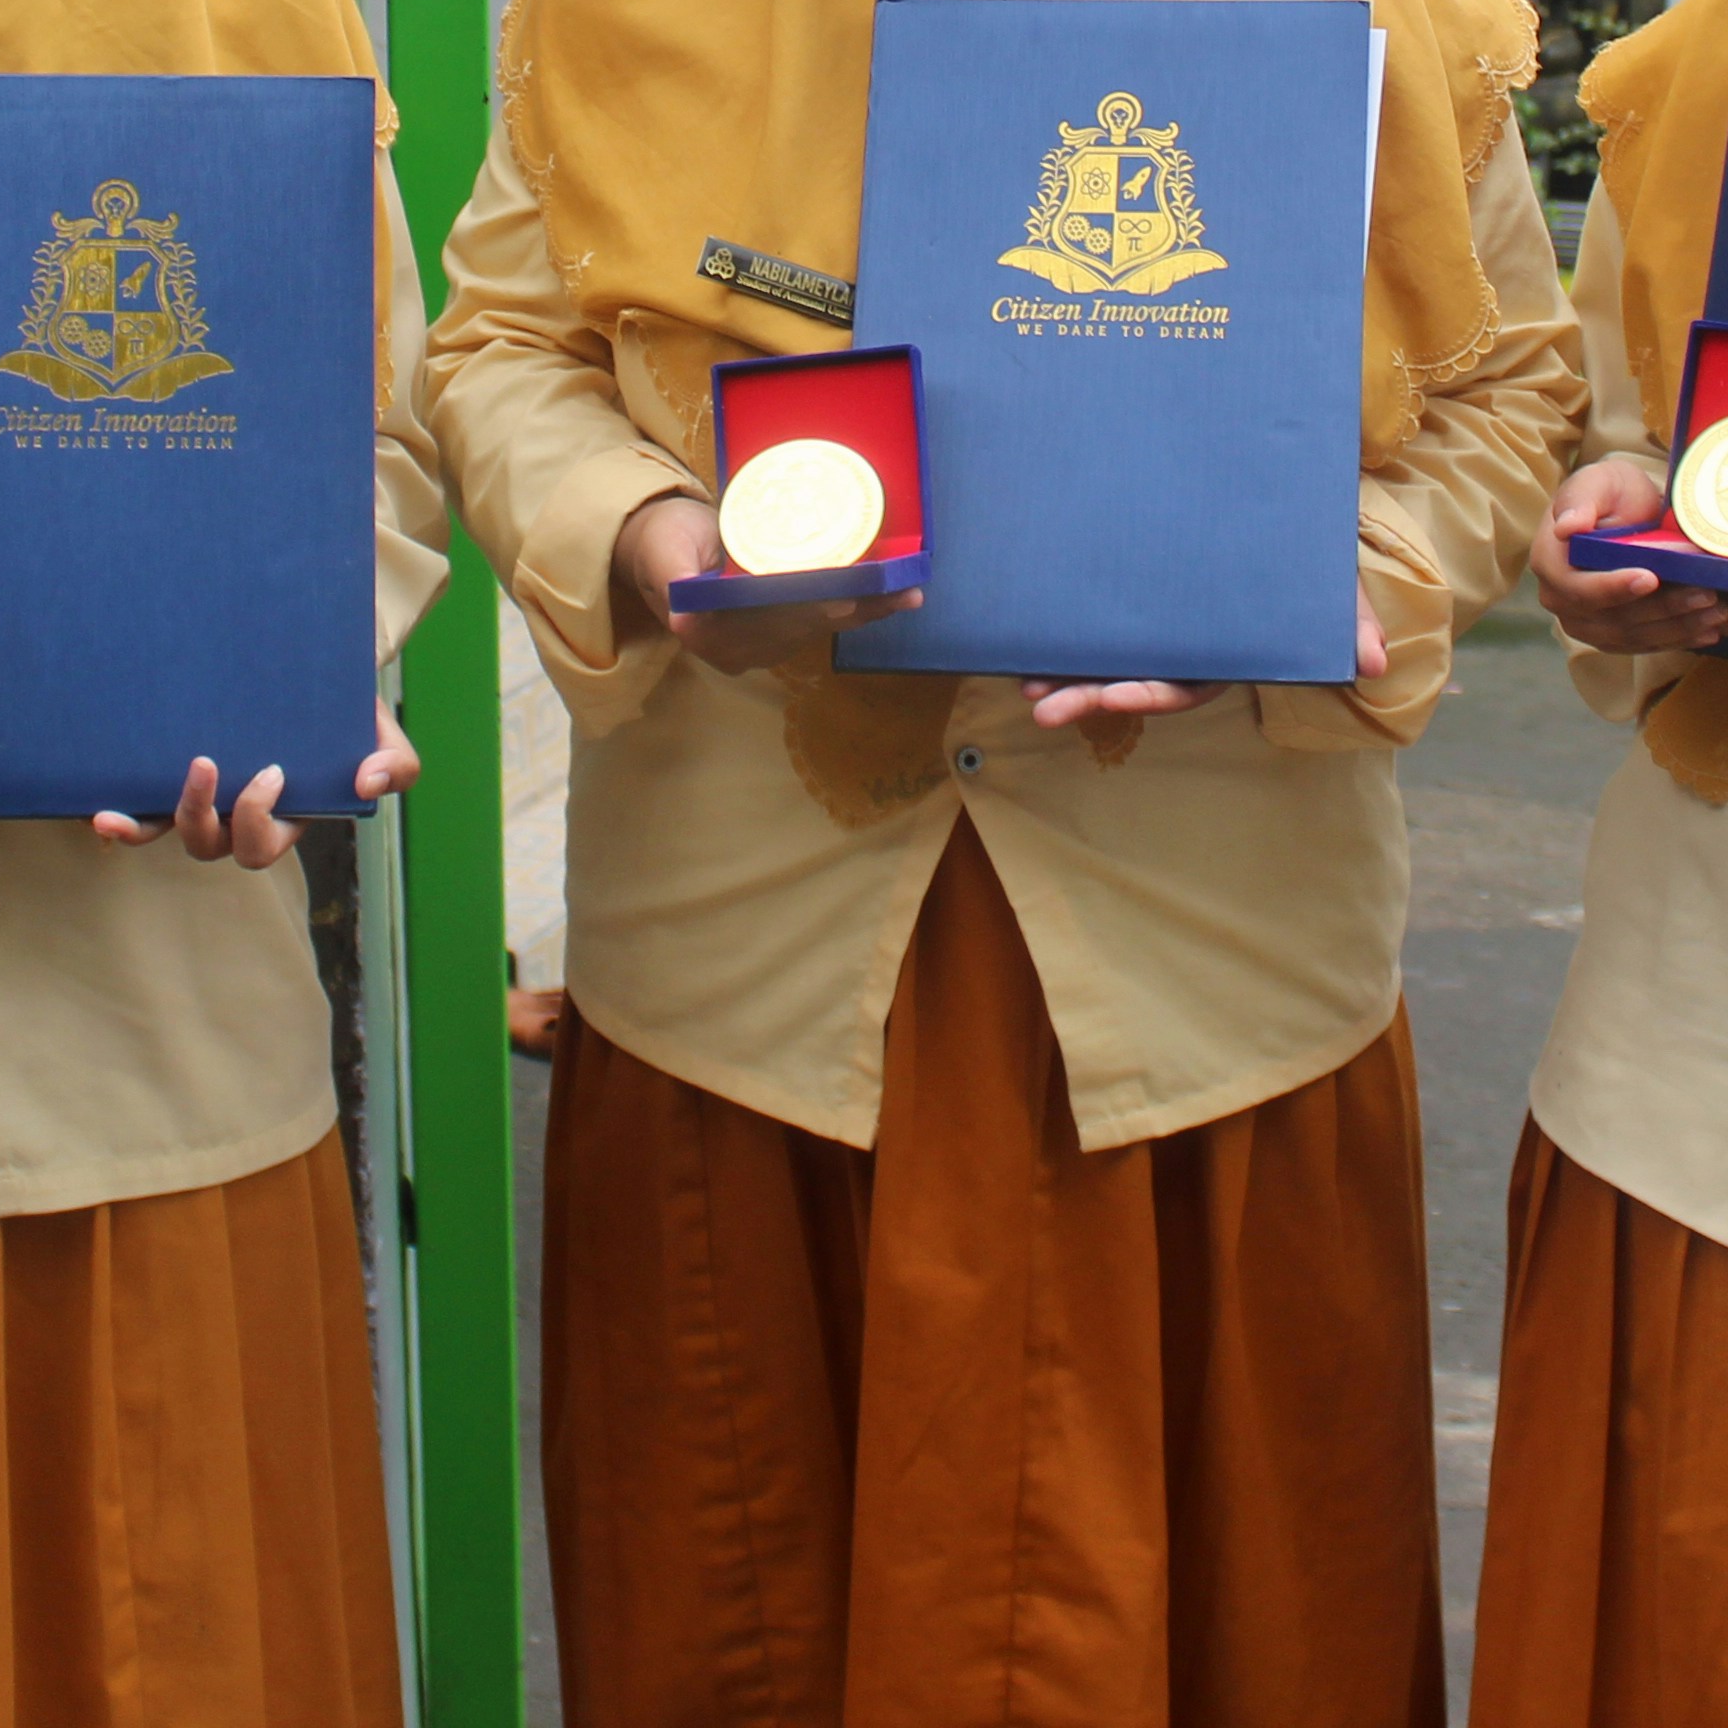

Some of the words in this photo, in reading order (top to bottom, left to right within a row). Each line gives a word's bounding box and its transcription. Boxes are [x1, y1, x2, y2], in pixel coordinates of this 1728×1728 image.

[991, 296, 1082, 323] Citizen
[1088, 299, 1230, 324] Innovation
[1016, 323, 1043, 336] WE
[1058, 324, 1107, 337] DARE
[1122, 325, 1145, 338] TO
[1160, 325, 1225, 339] DREAM
[88, 407, 238, 434] Innovation
[15, 435, 42, 449] WE
[58, 436, 110, 449] DARE
[125, 436, 149, 449] TO
[165, 437, 233, 449] DREAM
